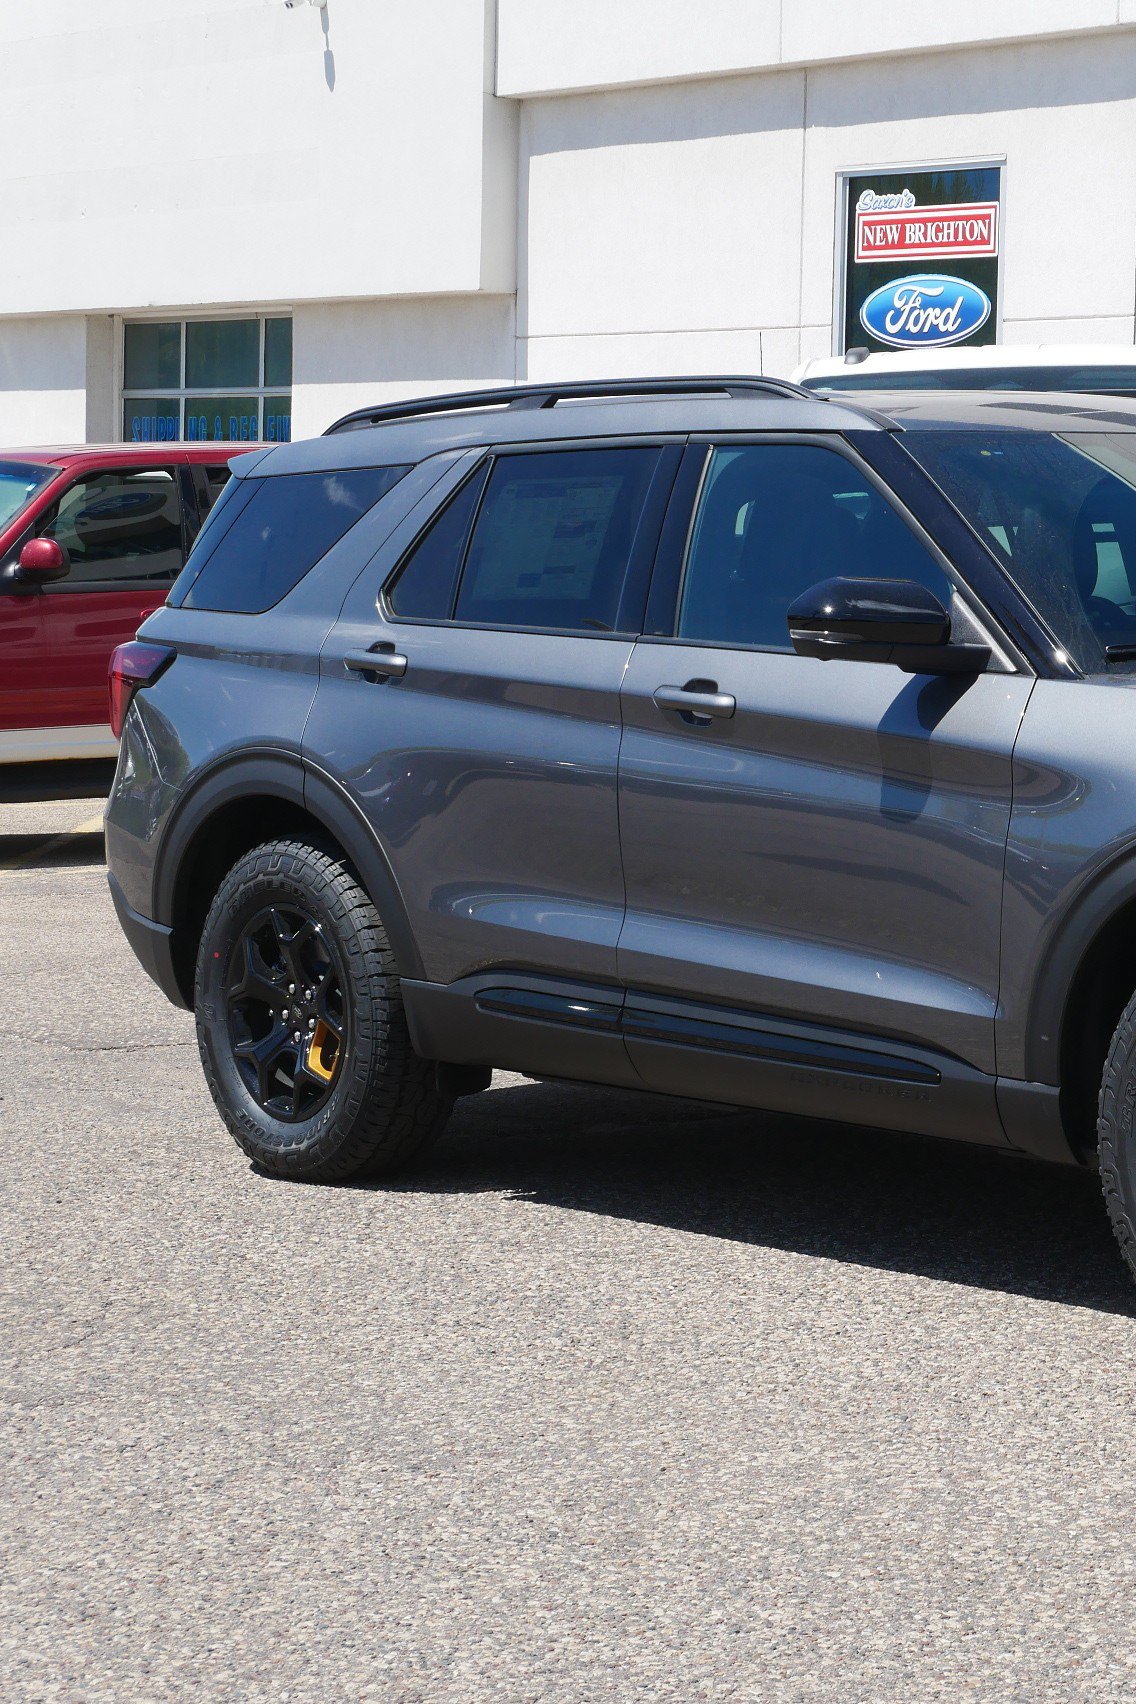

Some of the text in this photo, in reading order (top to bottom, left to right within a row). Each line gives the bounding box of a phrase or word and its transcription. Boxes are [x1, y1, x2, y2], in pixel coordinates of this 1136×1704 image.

[858, 189, 914, 211] Saxon's
[863, 219, 990, 247] NEW BRIGHTON
[885, 285, 963, 334] Ford
